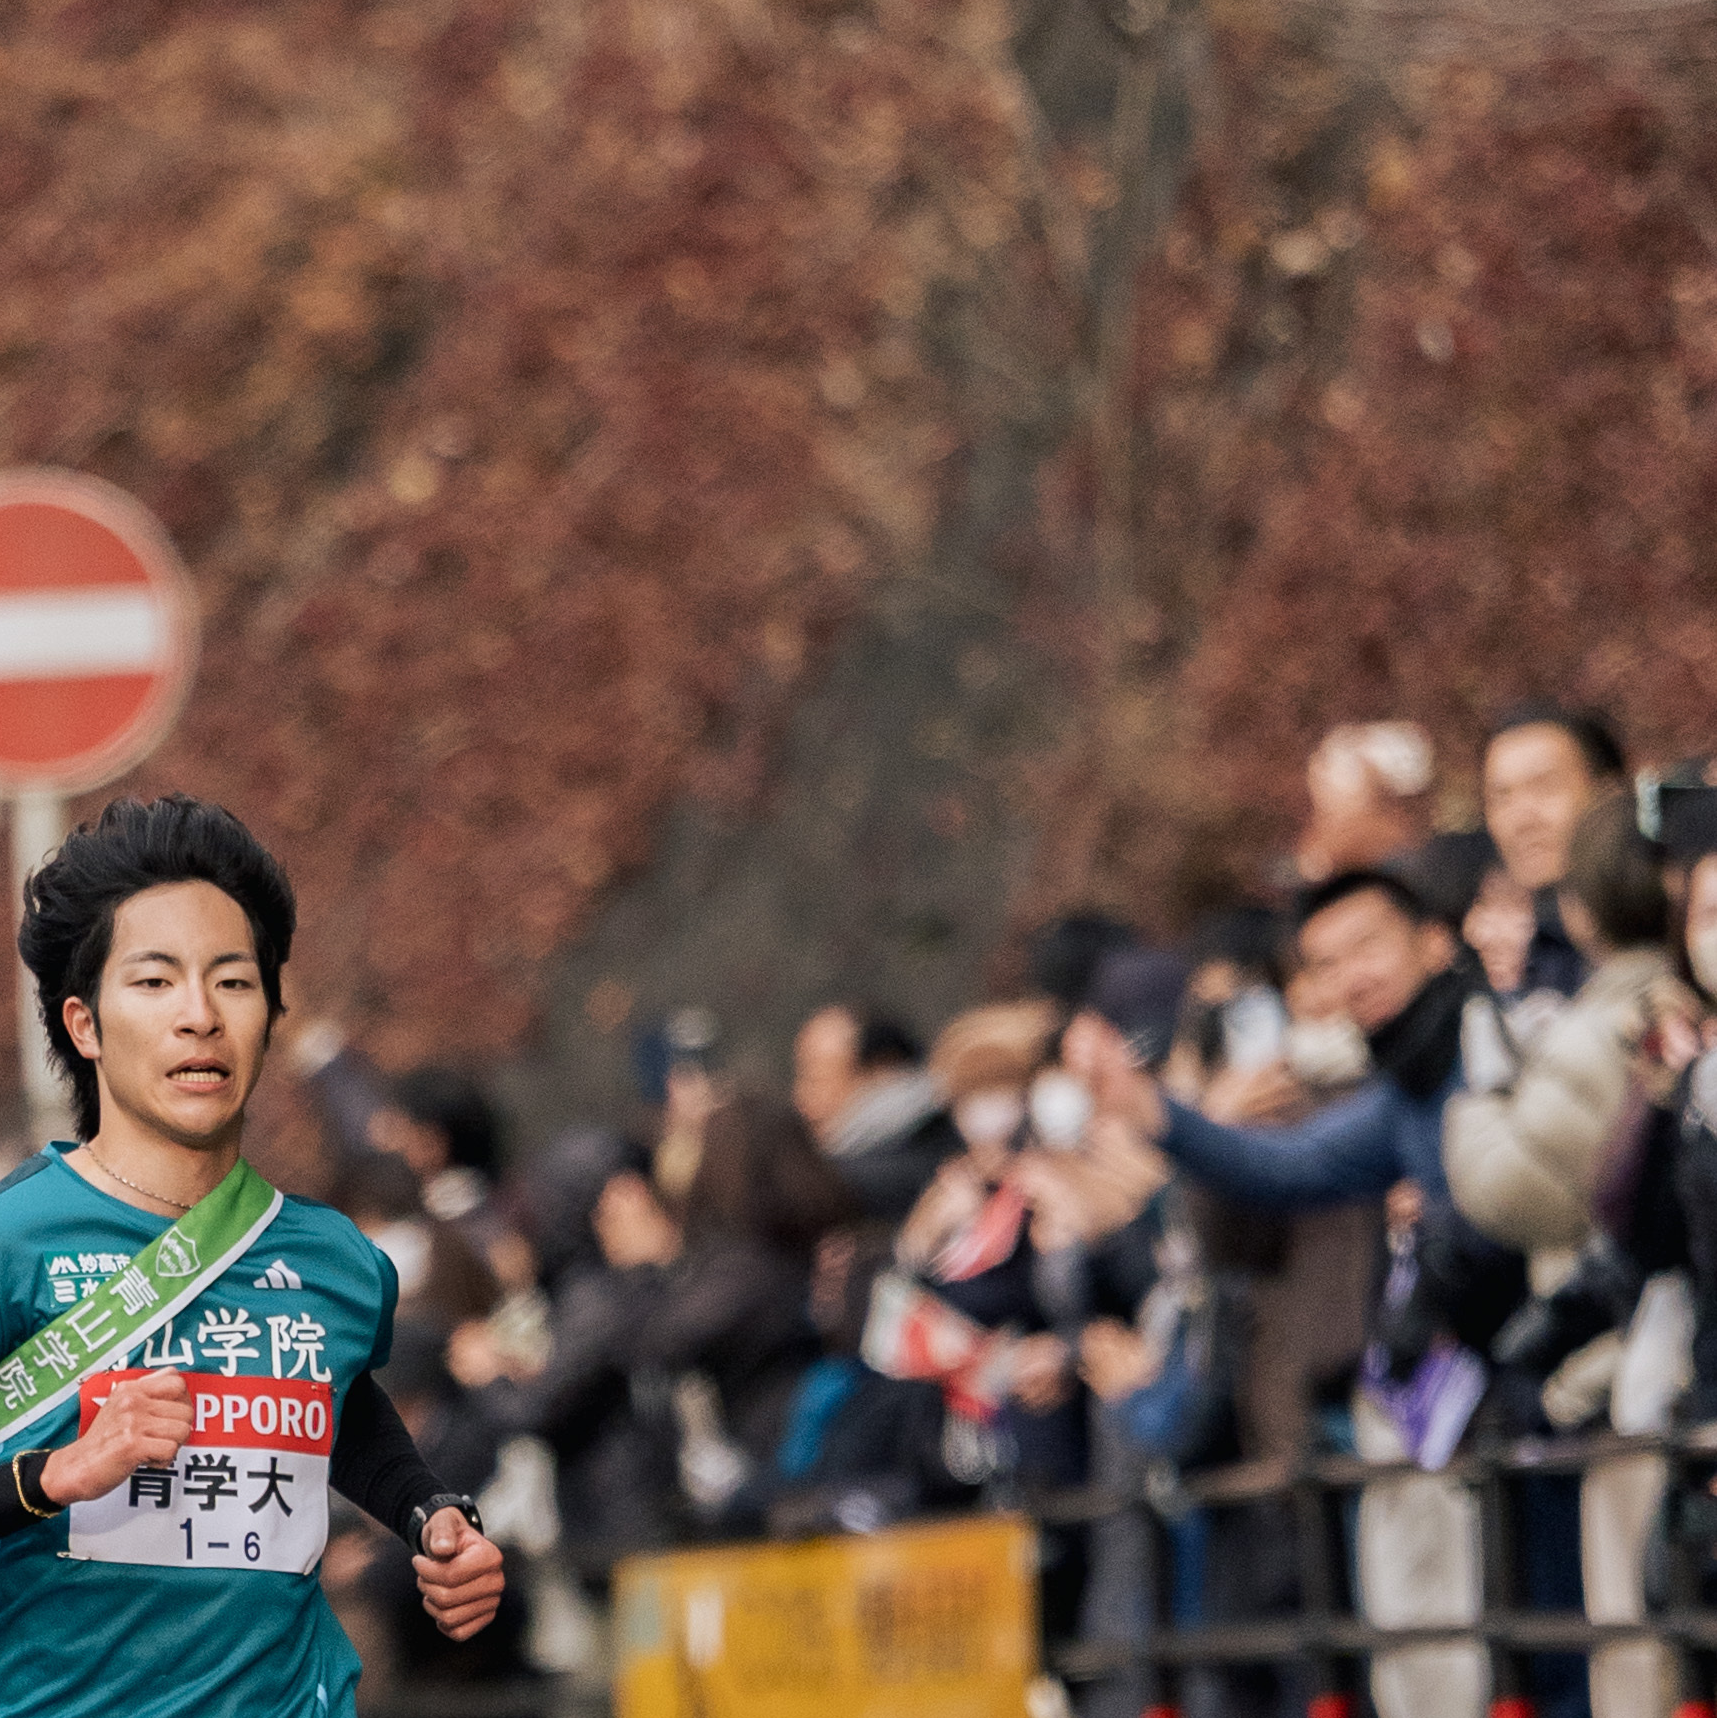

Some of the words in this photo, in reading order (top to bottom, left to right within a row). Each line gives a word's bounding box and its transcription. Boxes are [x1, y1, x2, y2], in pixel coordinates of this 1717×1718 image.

[77, 1253, 131, 1273] 妙高市
[112, 1307, 333, 1383] 山学院
[190, 1393, 327, 1441] PPORO
[128, 1453, 294, 1518] 青学大
